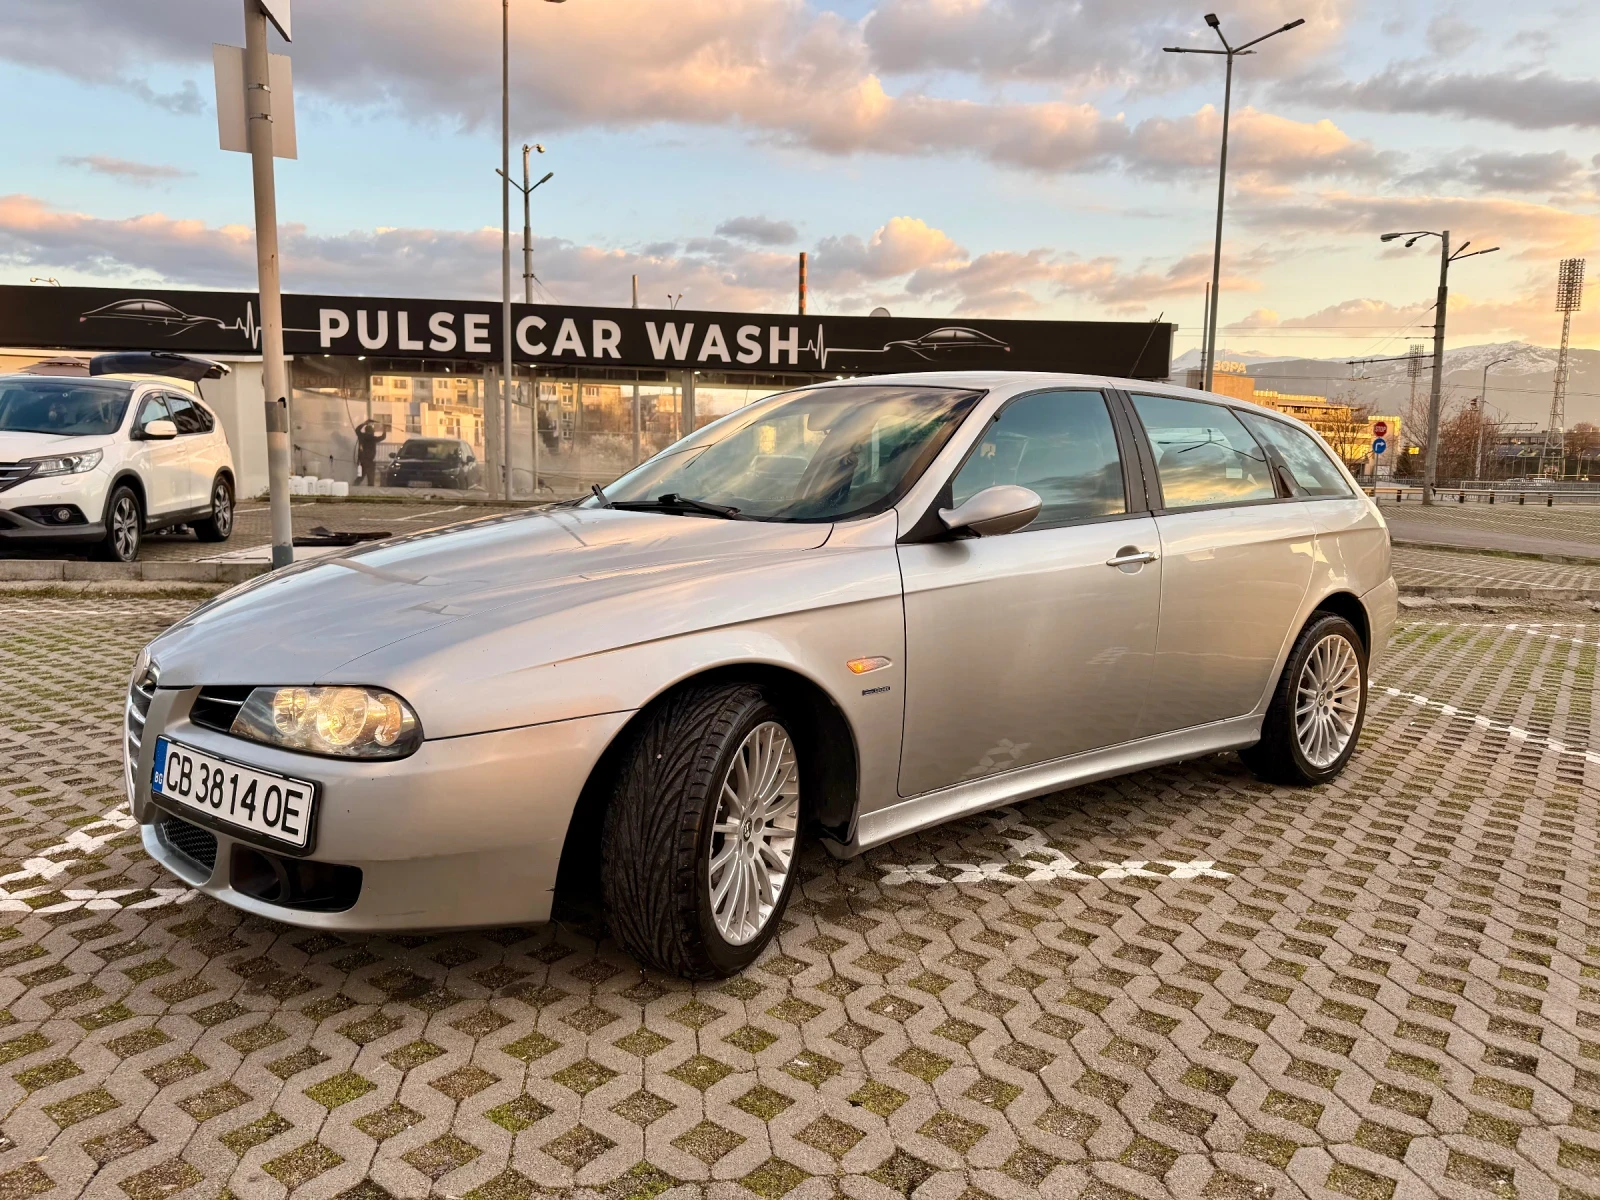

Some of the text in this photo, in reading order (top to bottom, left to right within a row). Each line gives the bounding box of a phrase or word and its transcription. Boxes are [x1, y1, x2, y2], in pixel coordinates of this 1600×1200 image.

[319, 308, 799, 365] PULSE CAR WASH
[1375, 425, 1387, 433] STOP
[154, 771, 164, 785] BG
